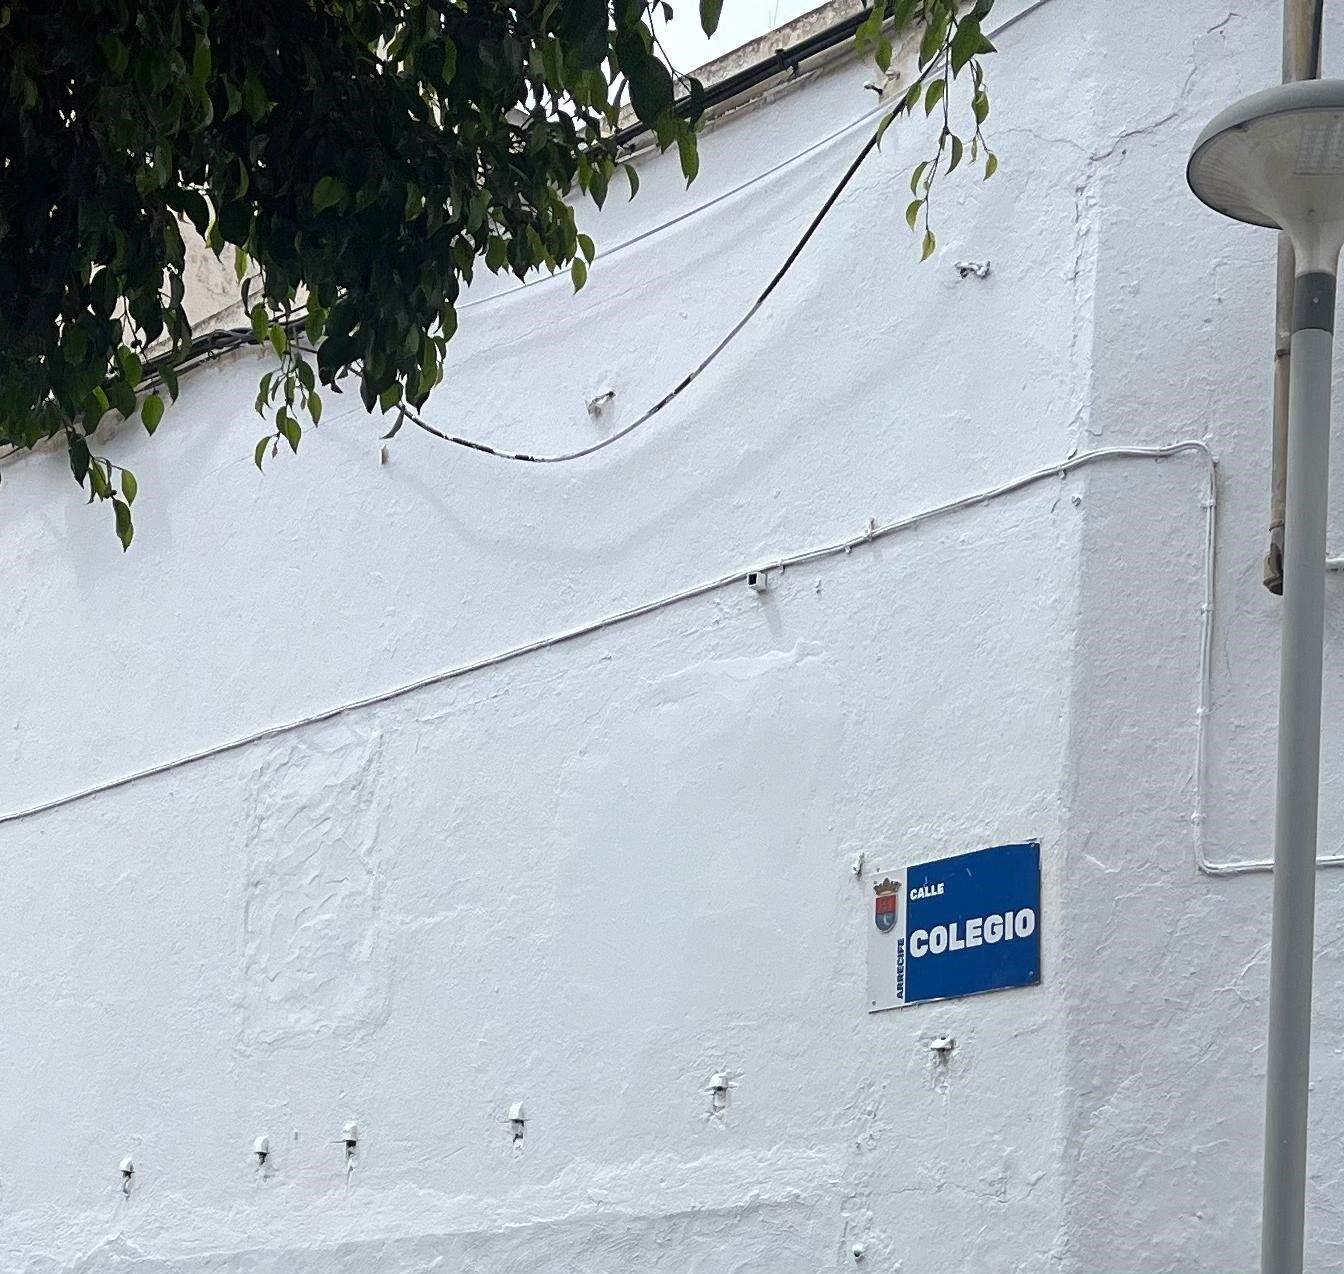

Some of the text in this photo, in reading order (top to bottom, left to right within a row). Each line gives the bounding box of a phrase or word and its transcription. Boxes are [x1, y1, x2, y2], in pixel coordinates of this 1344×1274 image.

[910, 882, 945, 900] CALLE
[909, 908, 1036, 958] COLEGIO
[896, 937, 905, 1000] ARRECIFE
